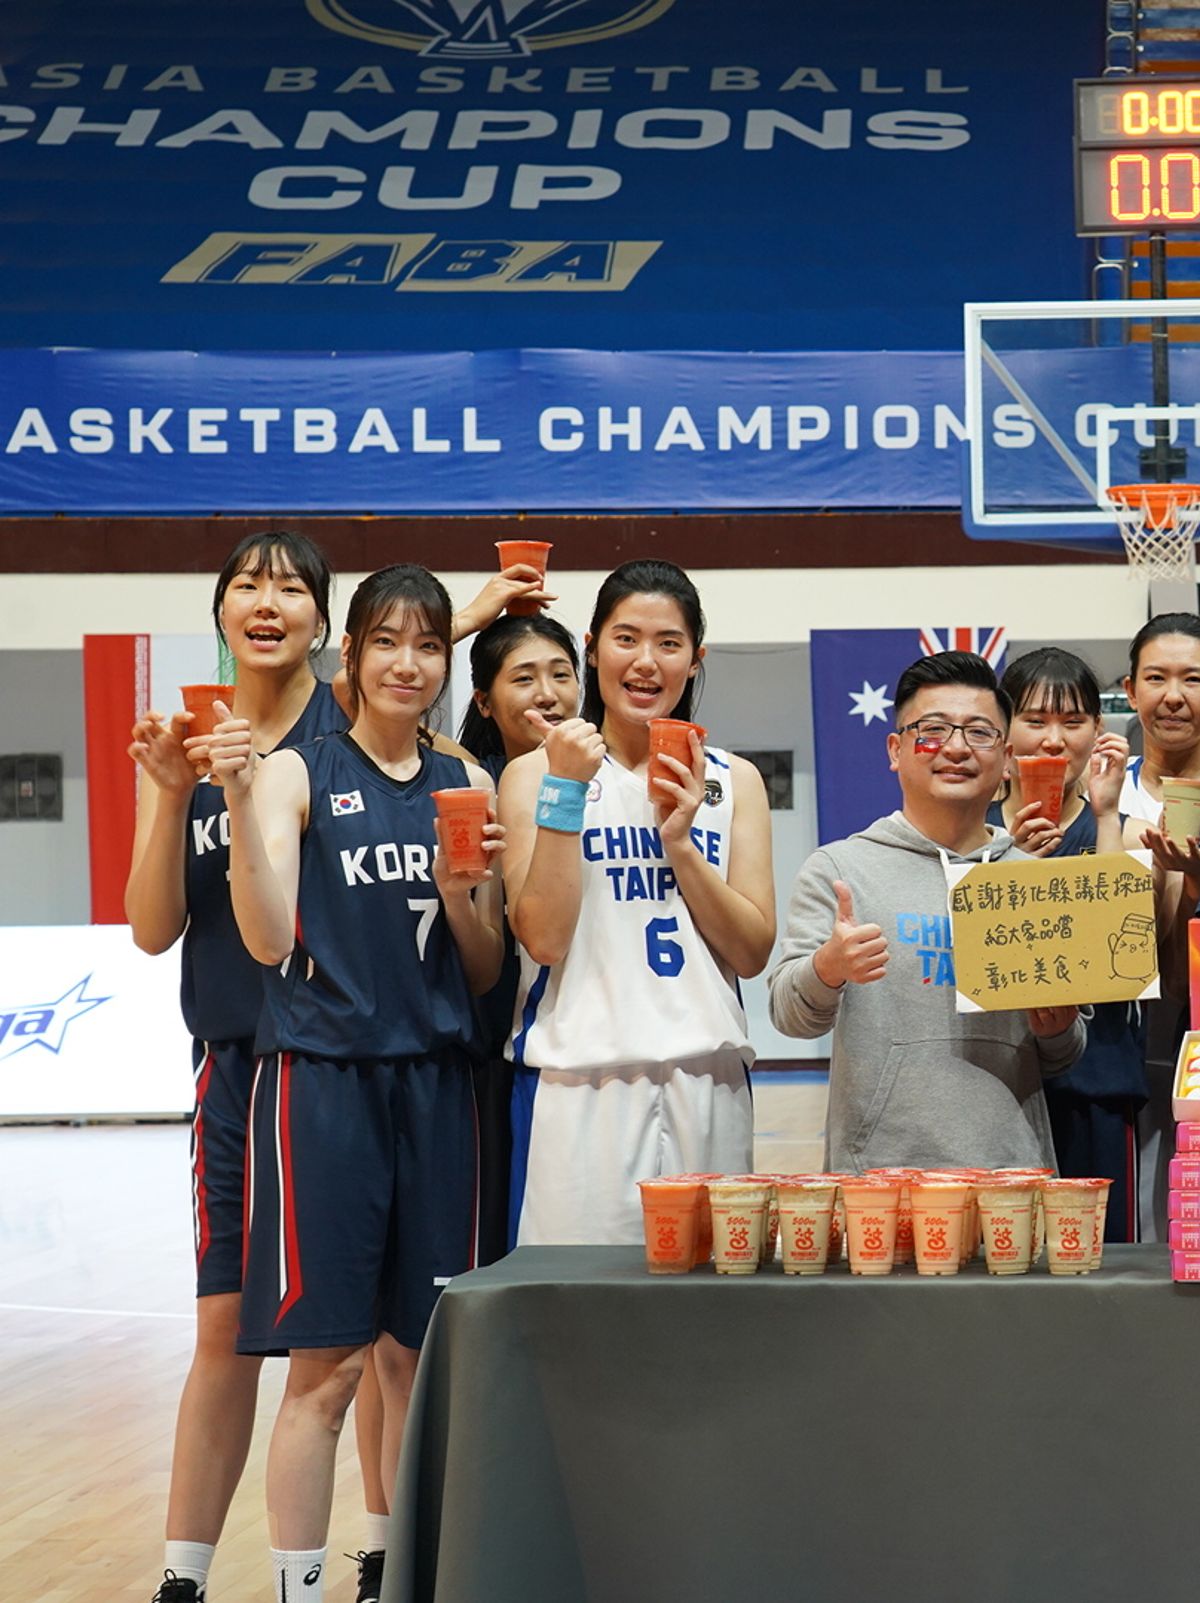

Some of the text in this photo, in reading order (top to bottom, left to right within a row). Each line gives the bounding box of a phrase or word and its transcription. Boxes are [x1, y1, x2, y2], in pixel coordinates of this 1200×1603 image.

[0, 63, 971, 94] SIA BASKETBALL
[247, 163, 622, 210] CUP
[1110, 153, 1200, 221] 0.0
[195, 238, 617, 285] FABA
[5, 407, 501, 454] ASKETBALL
[340, 842, 440, 887] KOR
[606, 866, 682, 901] TAIP
[407, 897, 439, 962] 7
[645, 916, 686, 978] 6
[985, 954, 1071, 991] 彰化美食
